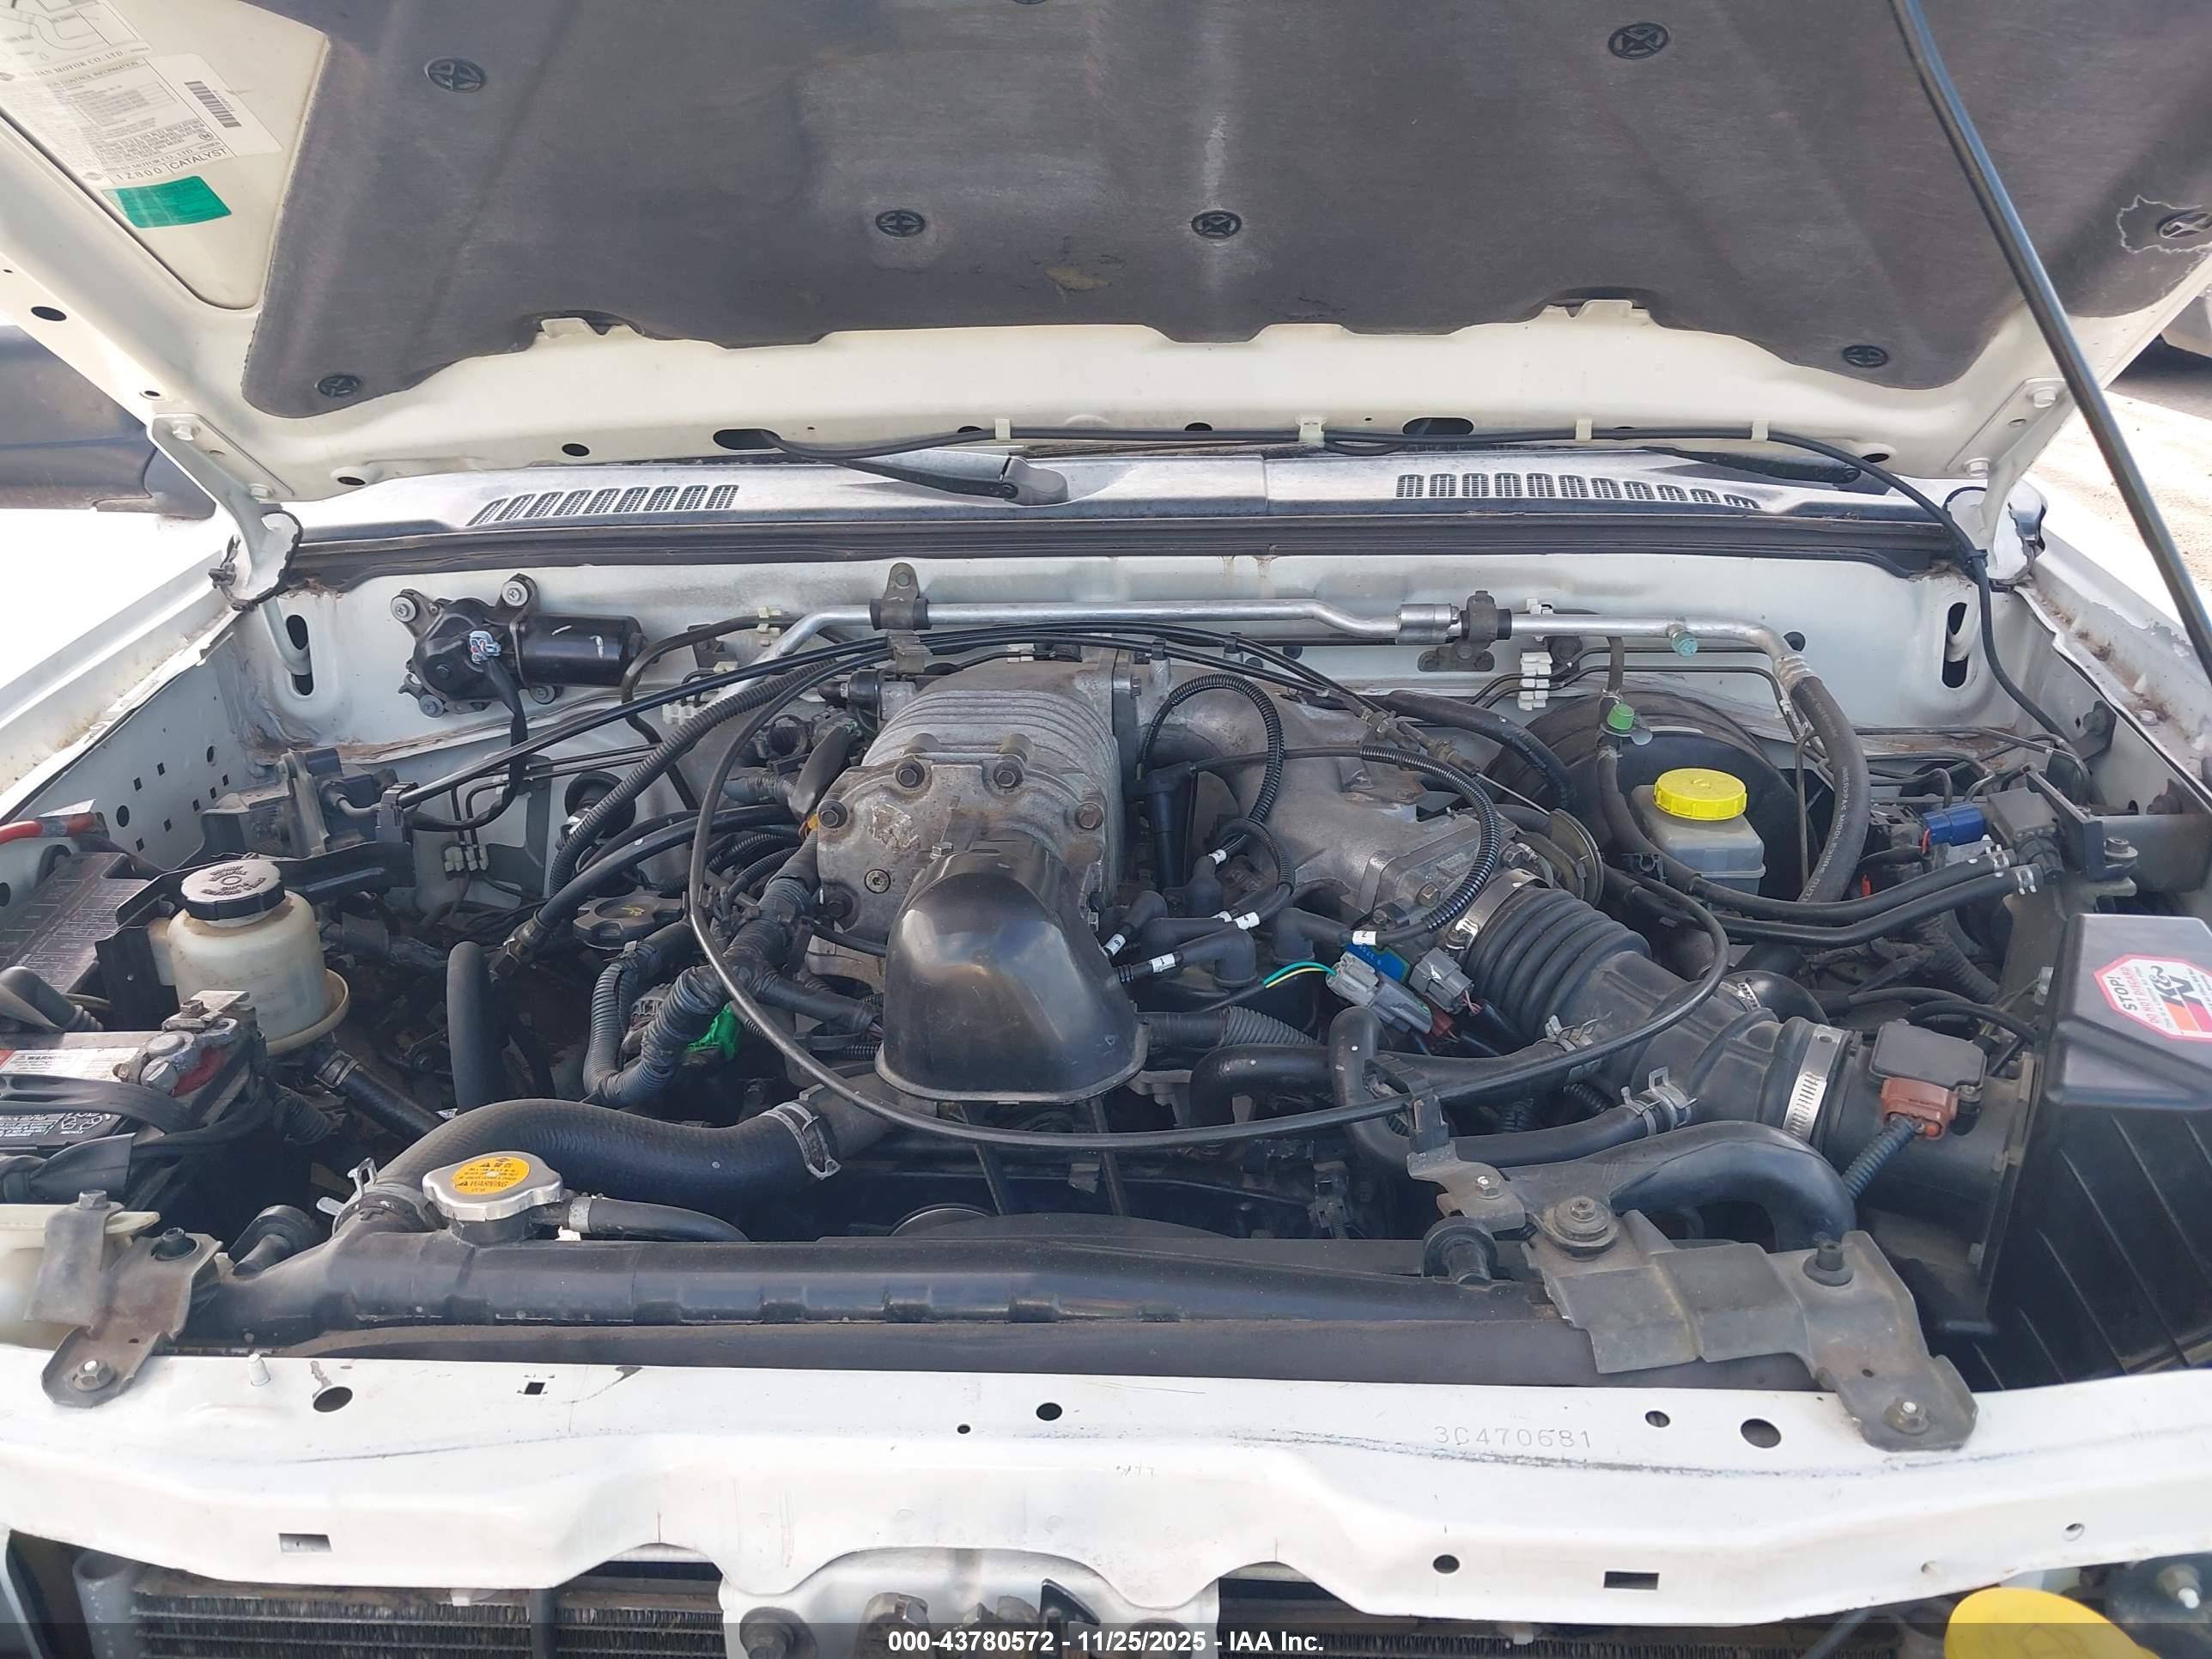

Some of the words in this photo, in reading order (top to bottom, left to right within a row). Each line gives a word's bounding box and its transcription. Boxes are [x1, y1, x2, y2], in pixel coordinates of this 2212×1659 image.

[169, 147, 228, 170] CATALYST
[2106, 975, 2138, 1011] STOP!
[470, 1180, 509, 1188] WARNING
[1433, 1425, 1591, 1449] 3C470681
